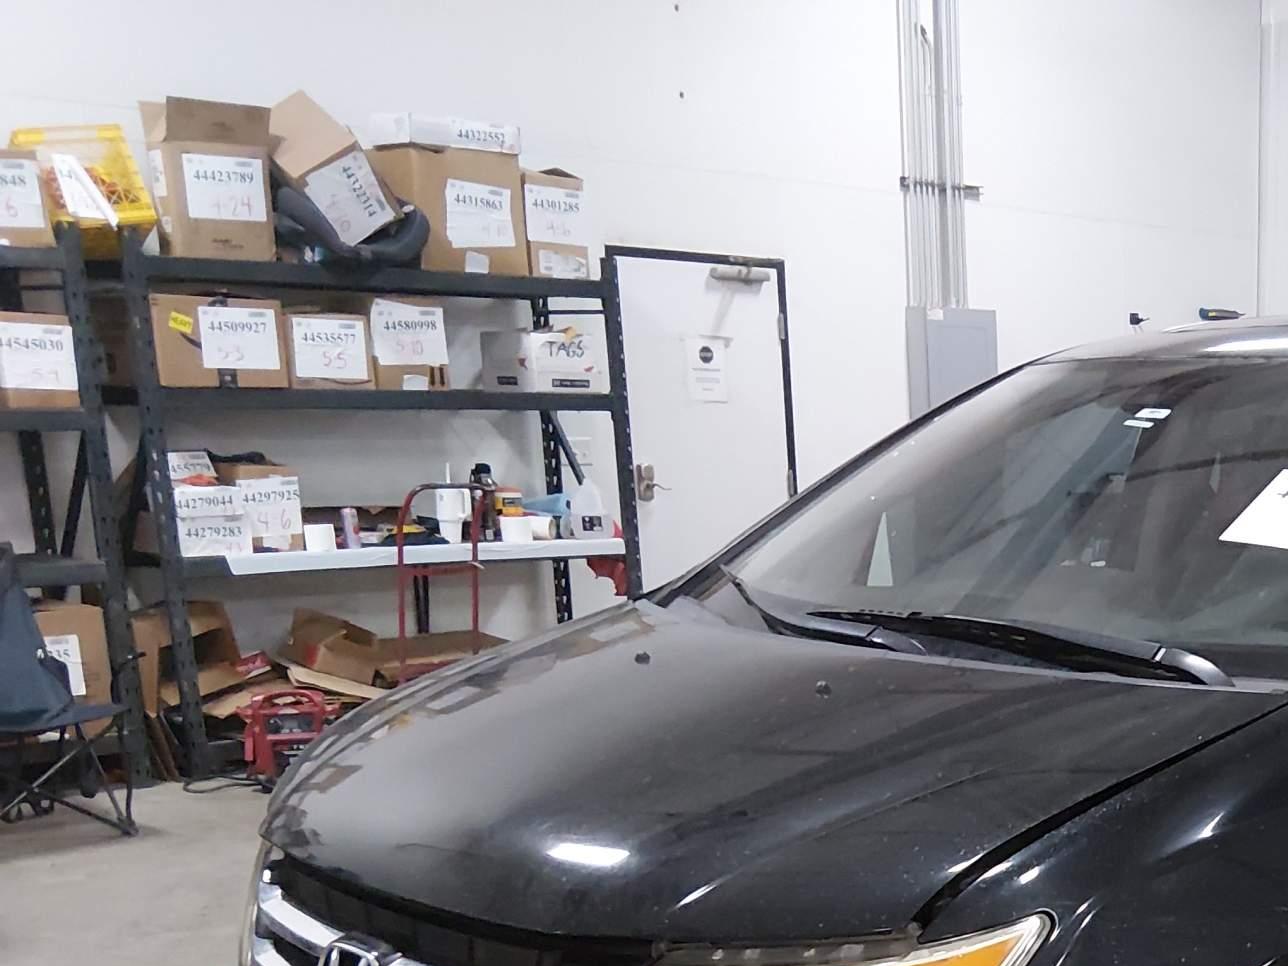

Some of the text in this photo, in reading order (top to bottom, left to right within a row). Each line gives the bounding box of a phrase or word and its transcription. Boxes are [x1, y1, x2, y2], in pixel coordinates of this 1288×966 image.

[193, 170, 255, 184] 44423789
[454, 193, 503, 210] 44315863
[532, 198, 580, 213] 44301285
[207, 320, 267, 334] 44509927
[383, 320, 437, 332] 44580998
[301, 331, 356, 345] 44535577
[545, 340, 585, 357] TAGS
[243, 489, 300, 504] 44297925
[185, 526, 242, 538] 44279283
